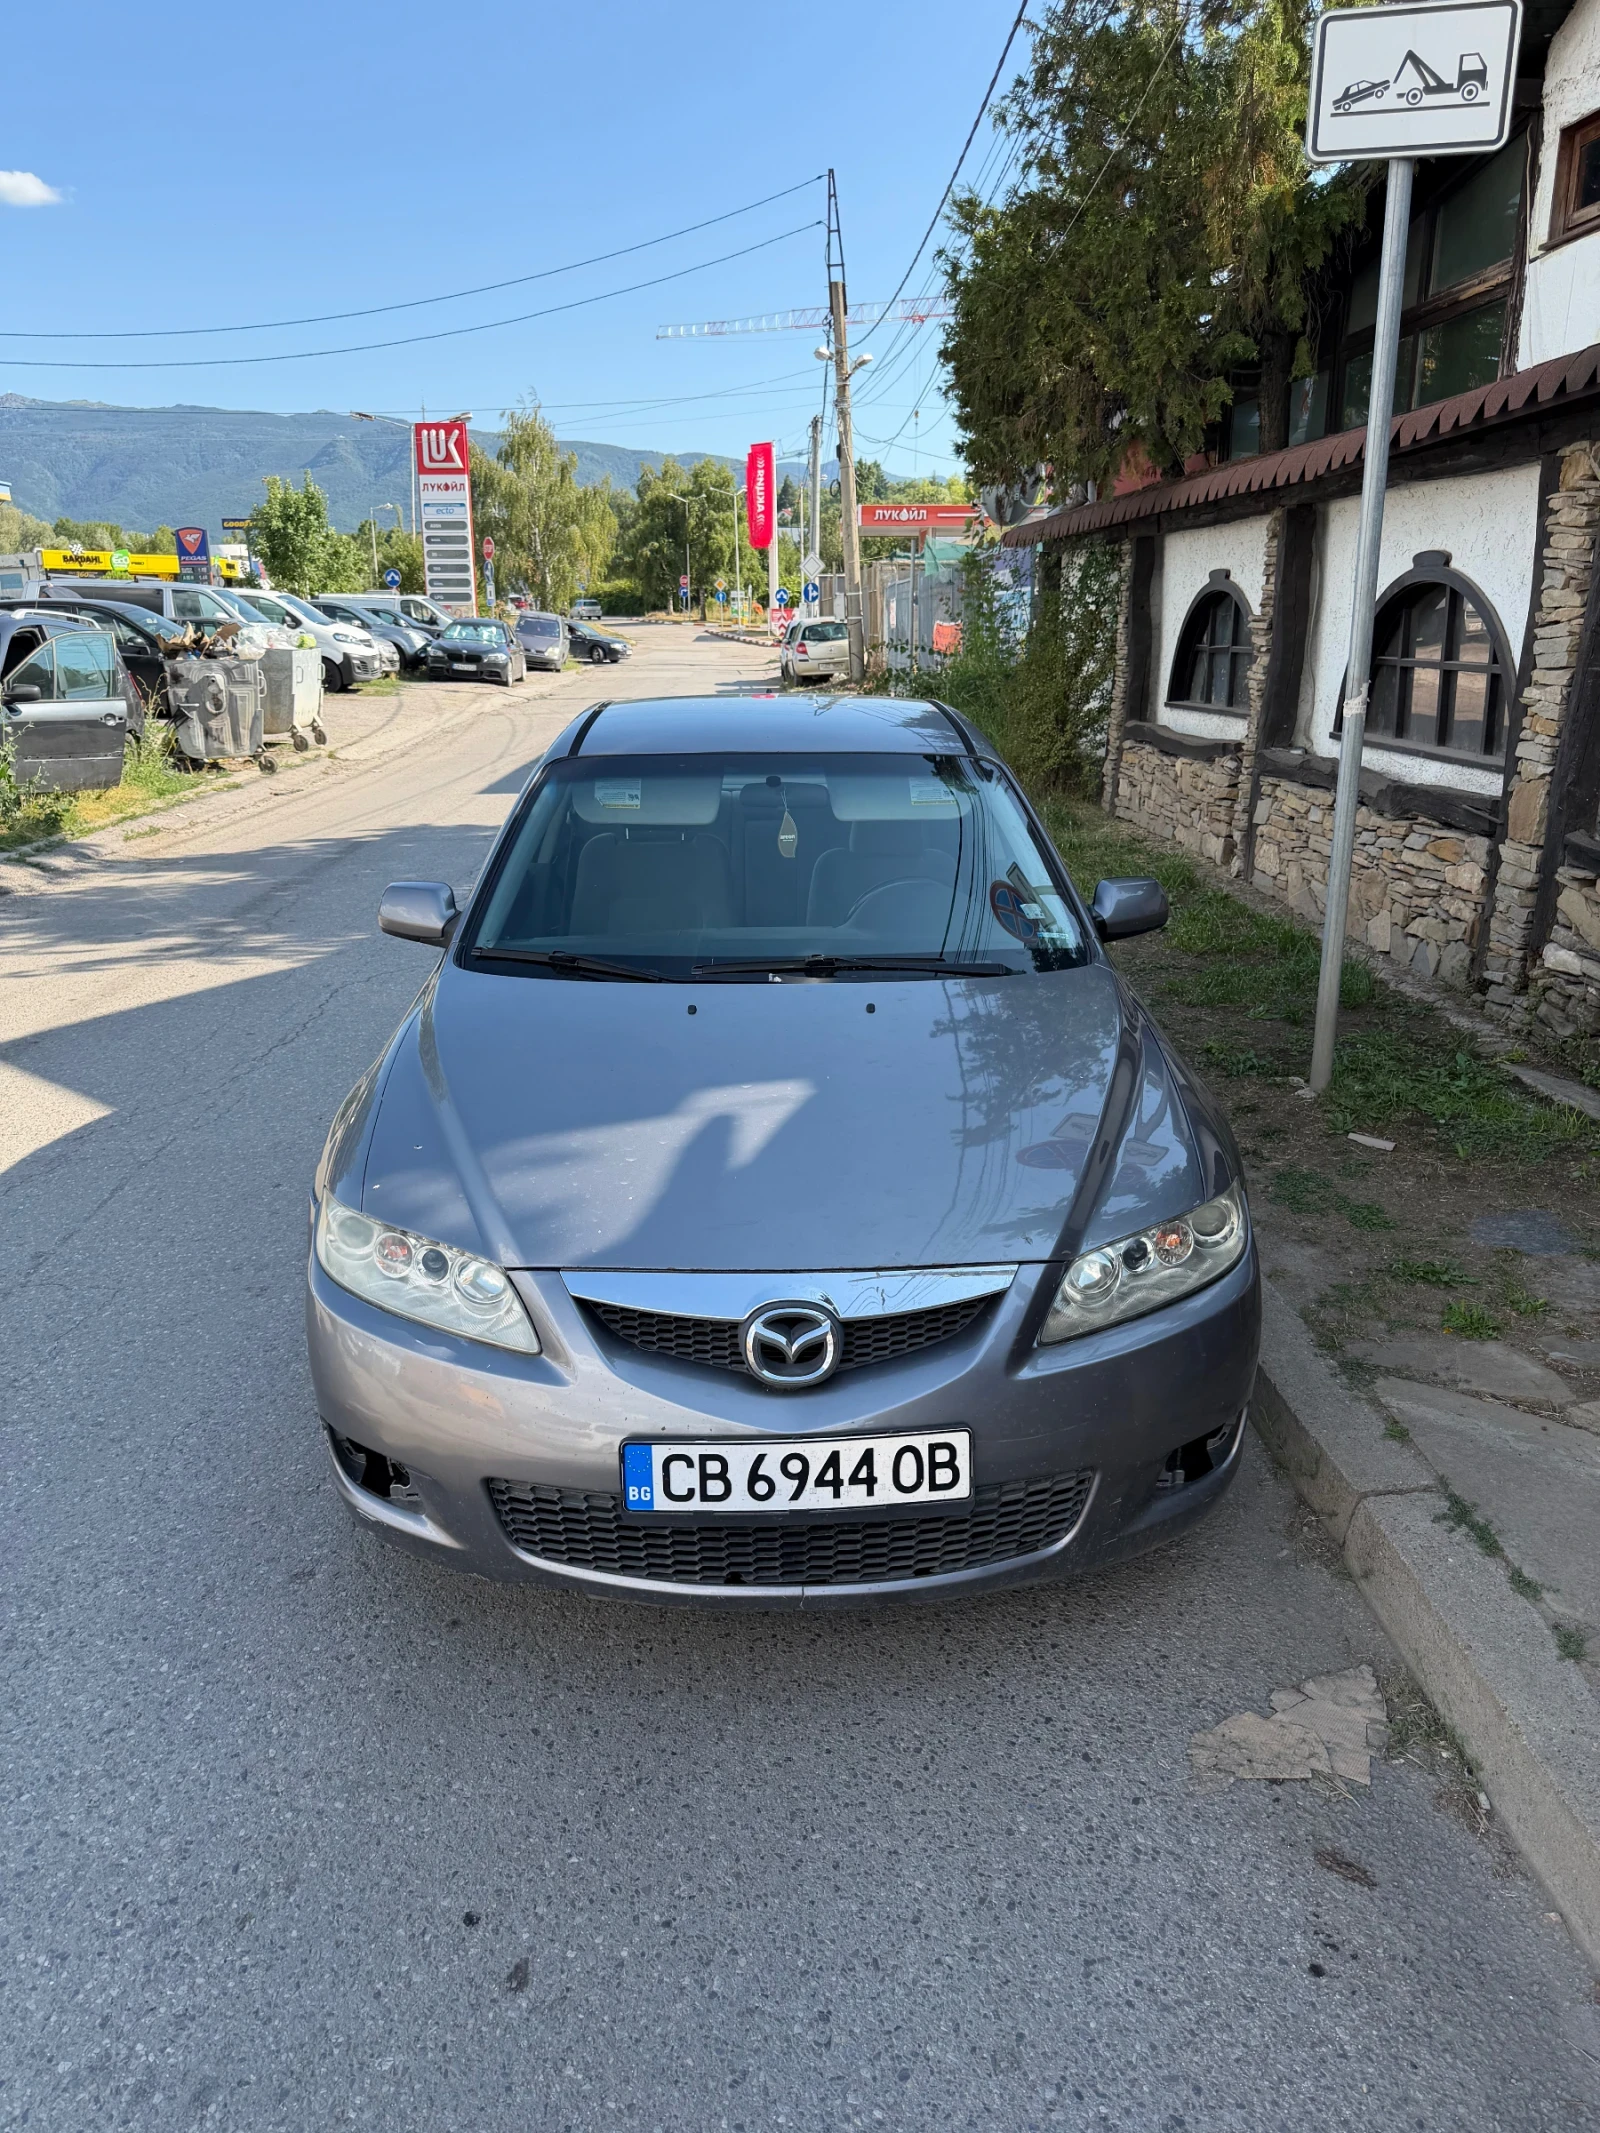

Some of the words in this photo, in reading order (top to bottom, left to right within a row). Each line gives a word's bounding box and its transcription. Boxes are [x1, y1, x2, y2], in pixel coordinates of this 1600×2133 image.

[422, 481, 465, 492] ЛУКОЙЛ
[874, 507, 927, 521] ЛУКОЙЛ
[62, 555, 103, 565] BARDAHL
[628, 1487, 651, 1501] BG
[661, 1453, 732, 1503] CB
[746, 1447, 878, 1502] 6944
